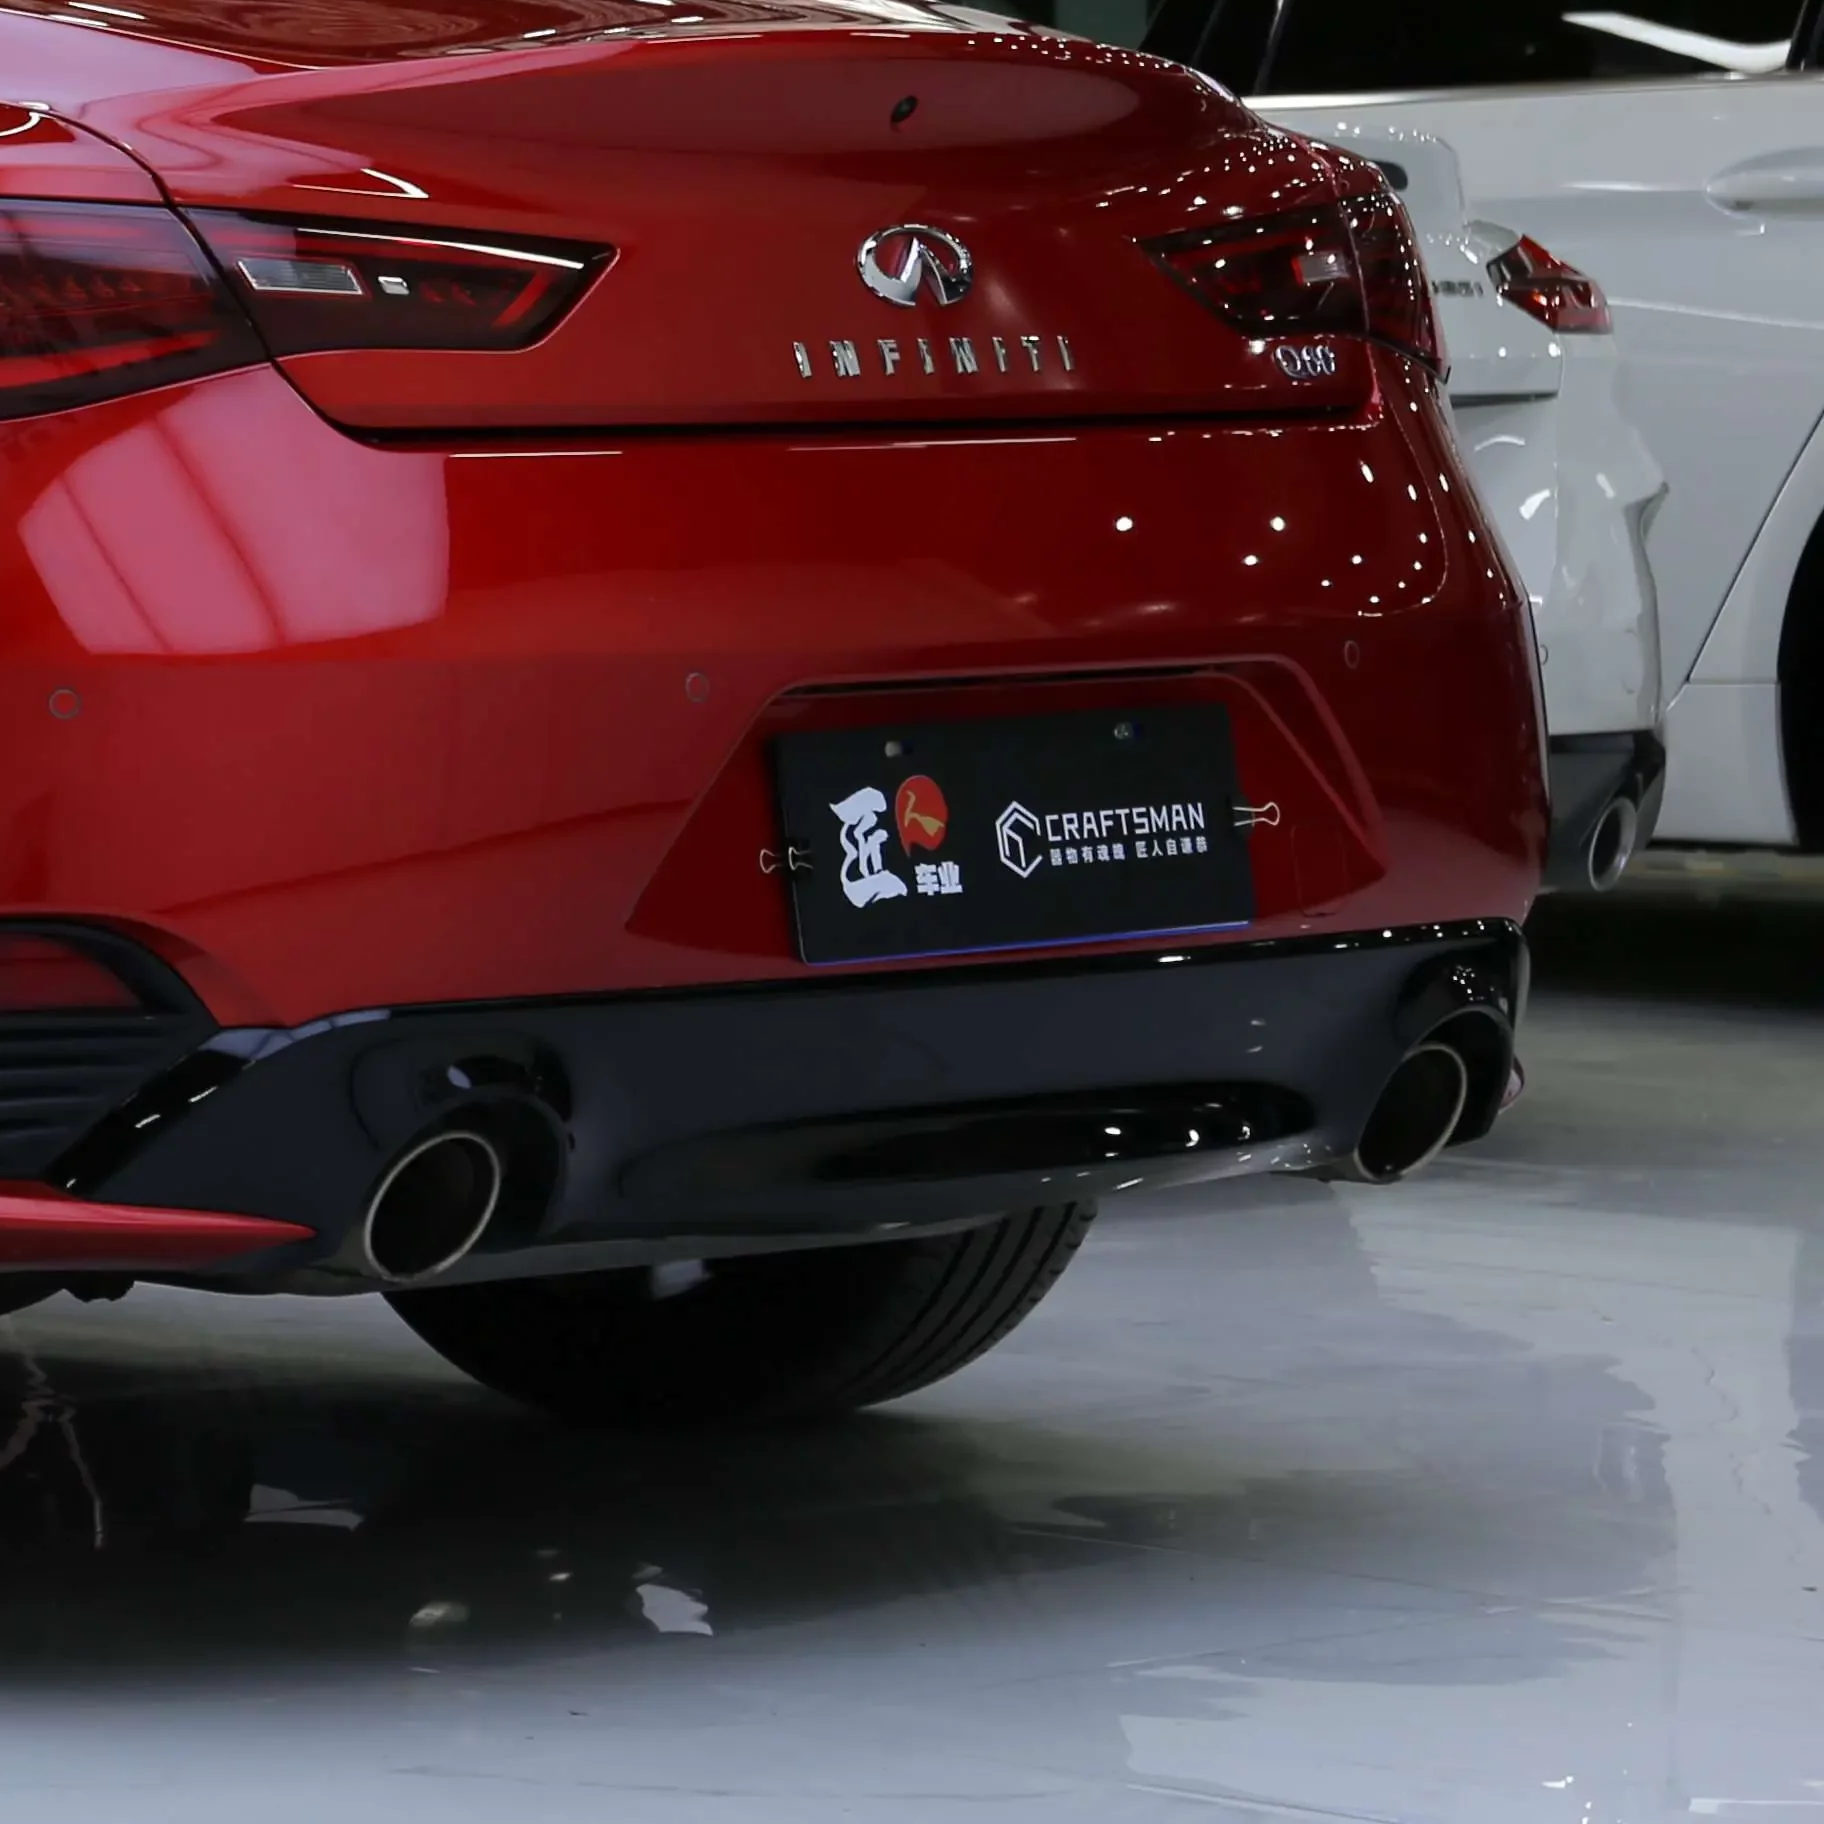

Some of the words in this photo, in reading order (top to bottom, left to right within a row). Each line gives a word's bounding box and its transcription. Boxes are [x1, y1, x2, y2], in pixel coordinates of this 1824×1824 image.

[791, 334, 1076, 378] INFINITI
[1044, 801, 1205, 842] CRAFTSMAN
[914, 860, 963, 897] 车业
